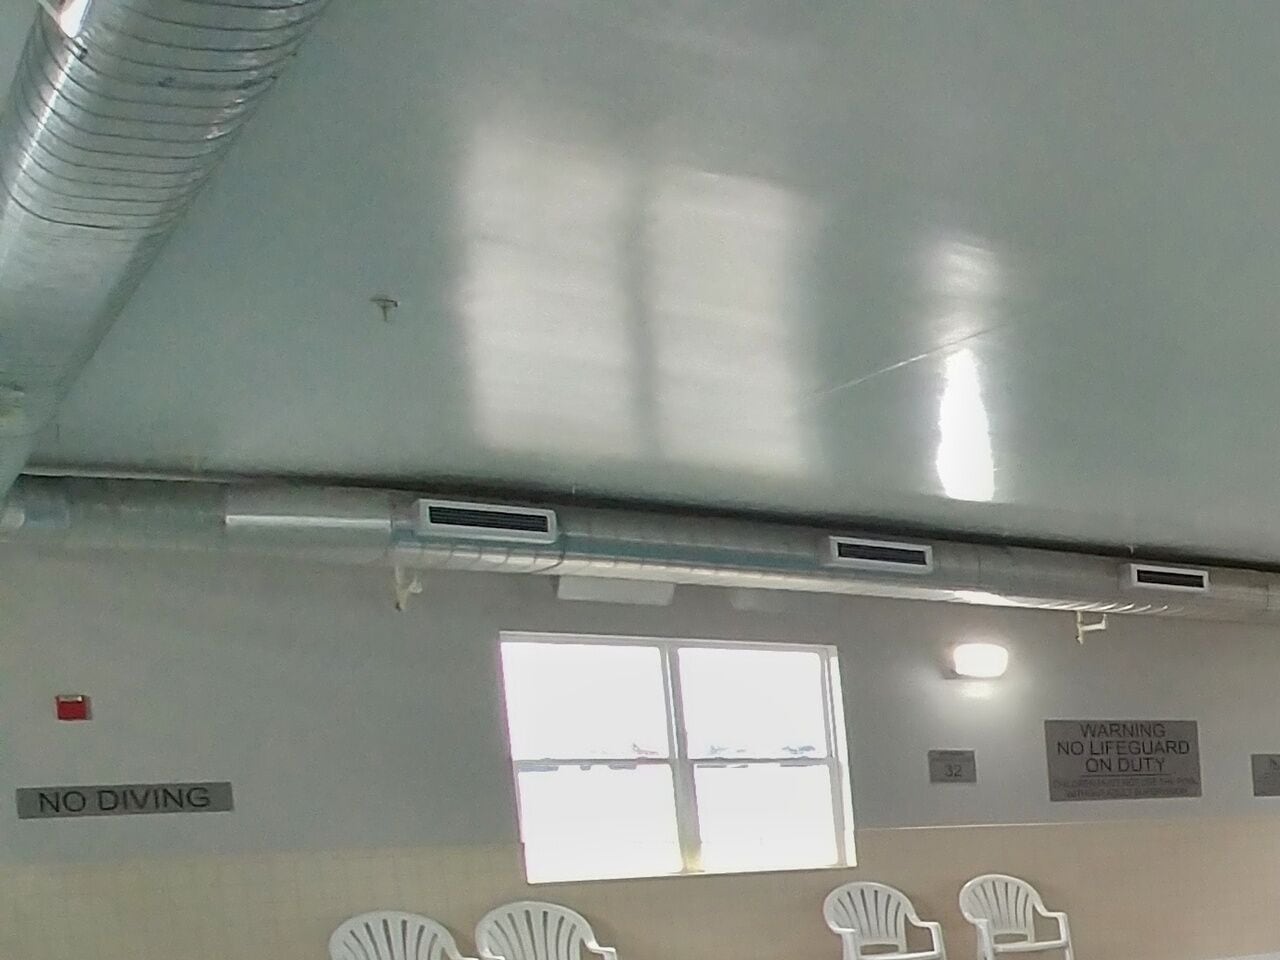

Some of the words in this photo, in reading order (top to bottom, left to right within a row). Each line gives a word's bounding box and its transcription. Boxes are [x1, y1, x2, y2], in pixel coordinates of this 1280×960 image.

[1080, 723, 1167, 738] WARNING
[1057, 741, 1084, 756] NO
[1090, 740, 1190, 756] LIFEGUARD
[944, 764, 962, 777] 32
[1085, 757, 1112, 773] ON
[1118, 757, 1165, 772] DUTY
[38, 790, 86, 812] NO
[97, 786, 211, 811] DIVING
